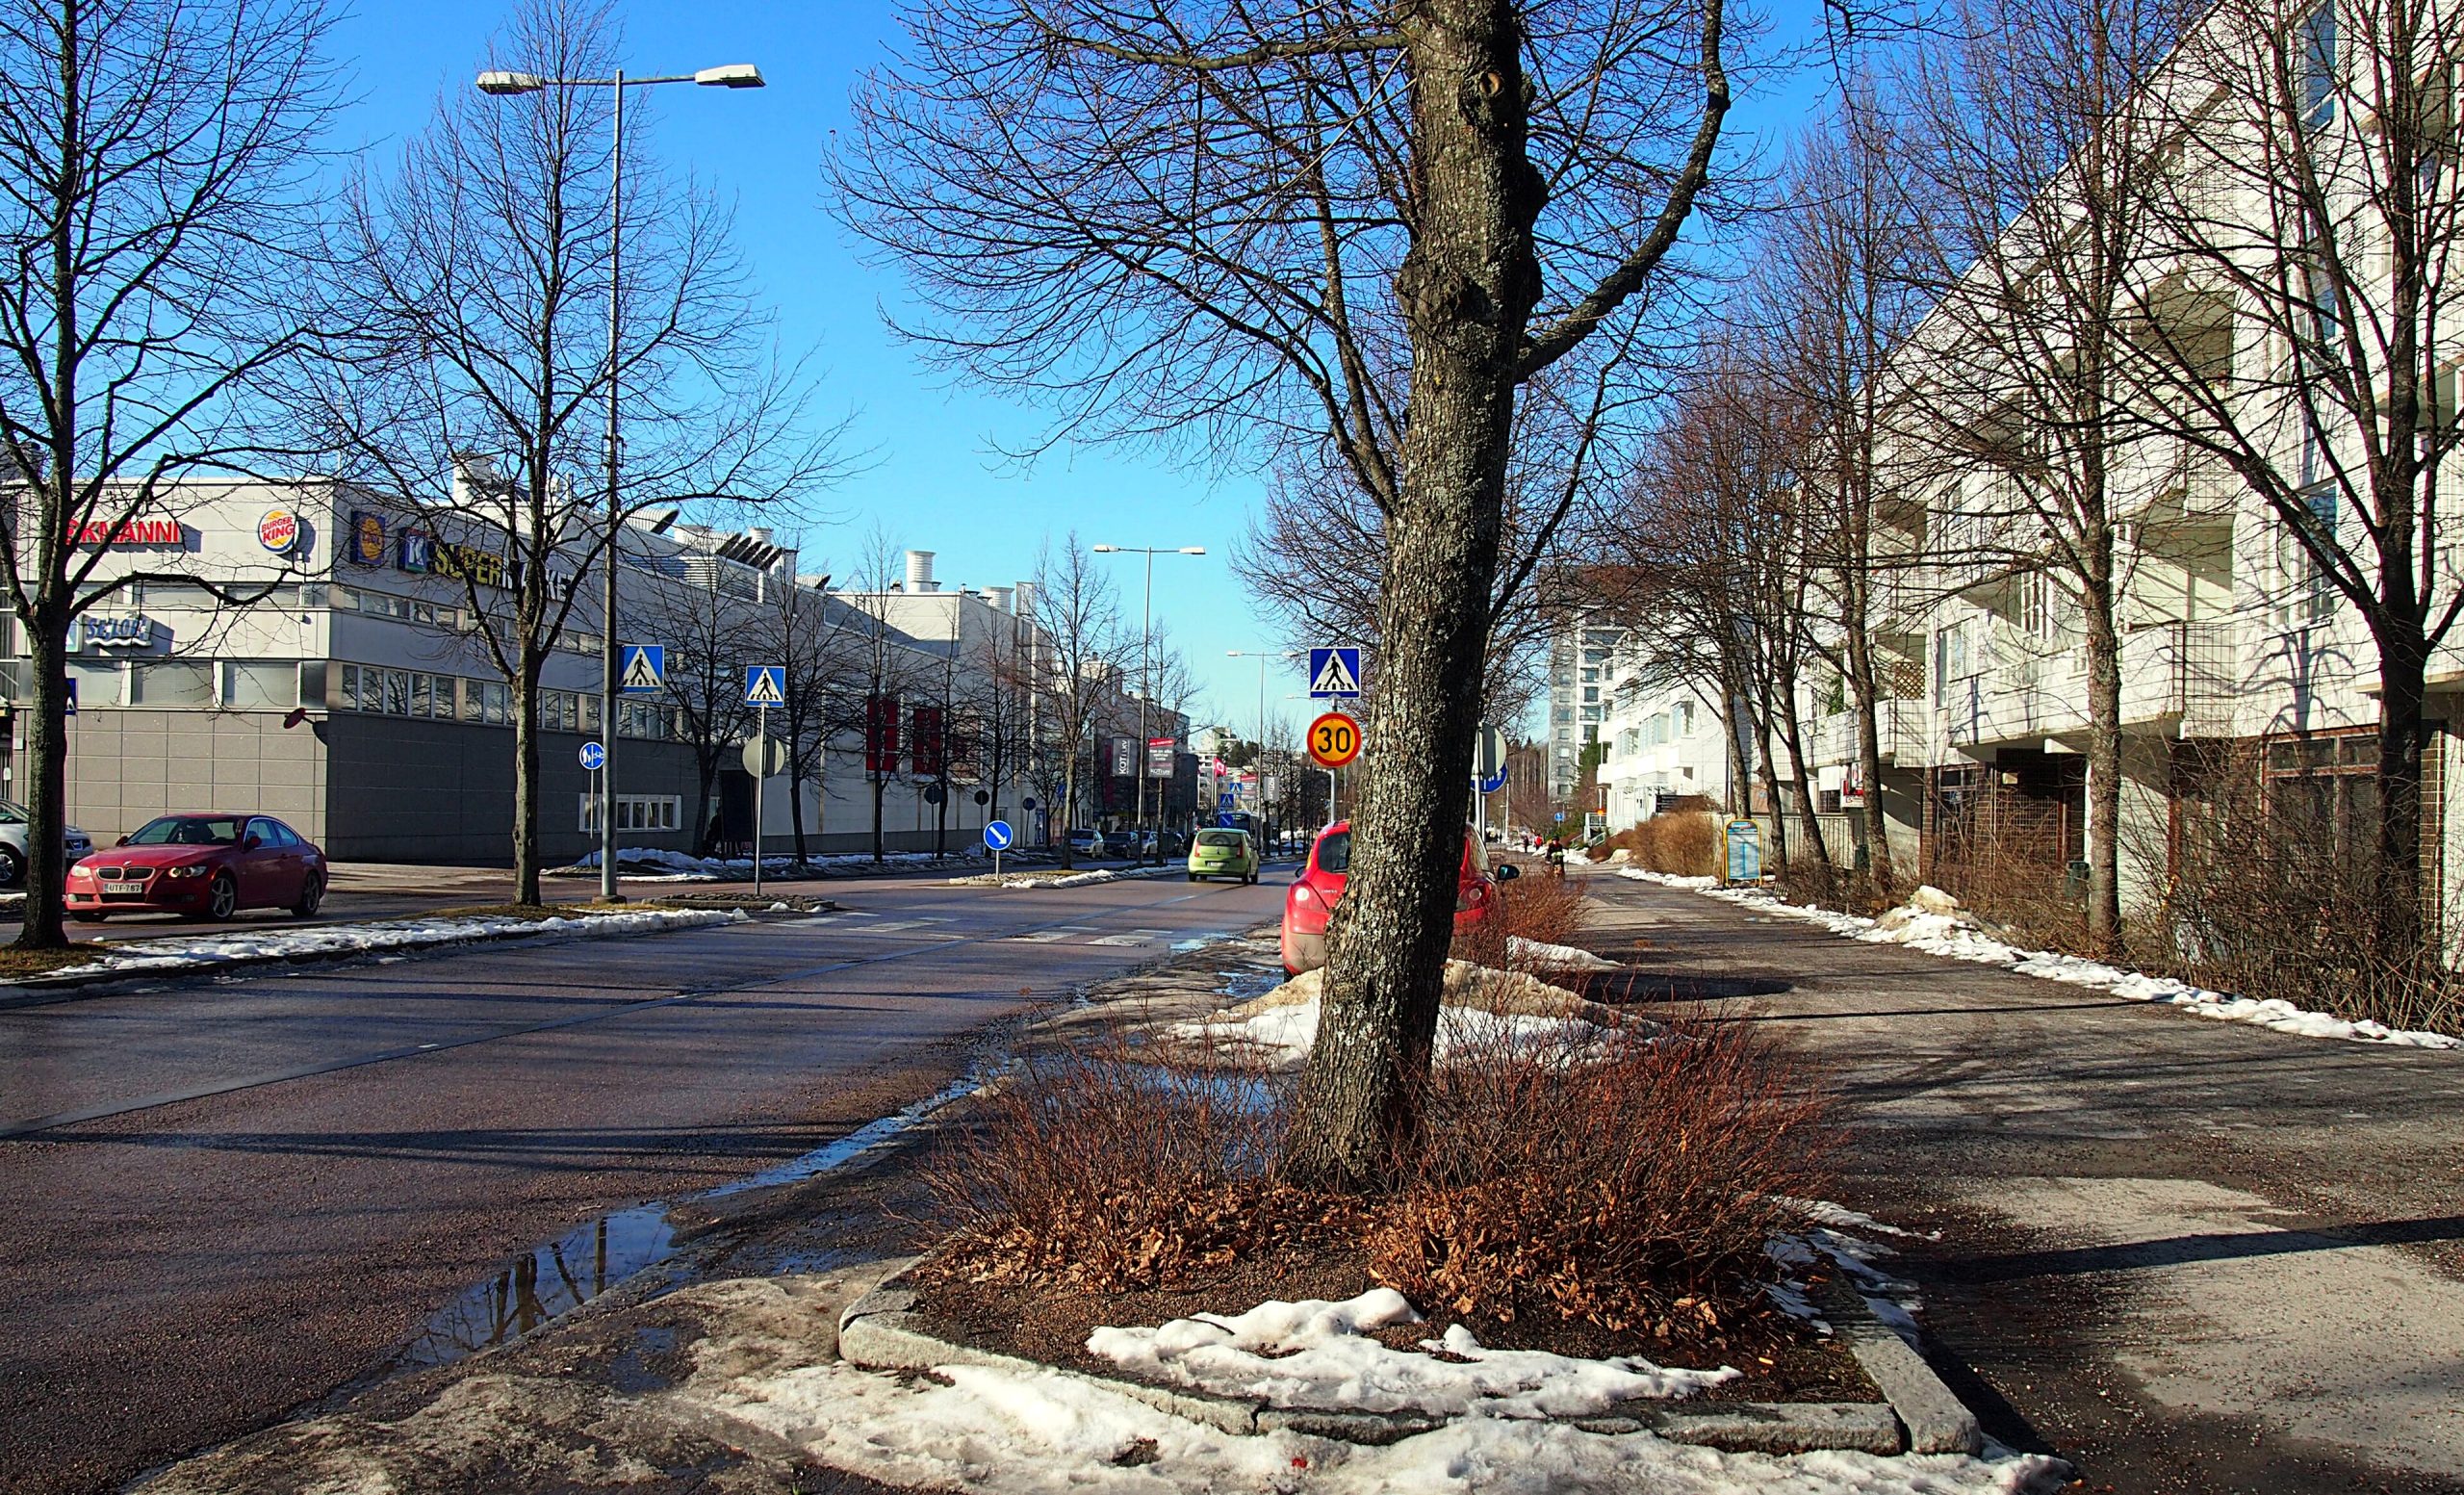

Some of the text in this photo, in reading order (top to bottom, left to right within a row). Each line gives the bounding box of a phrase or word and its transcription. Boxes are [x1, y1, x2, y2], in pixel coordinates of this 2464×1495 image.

[262, 516, 293, 532] BURGER
[263, 524, 295, 544] KING
[1318, 726, 1351, 754] 30
